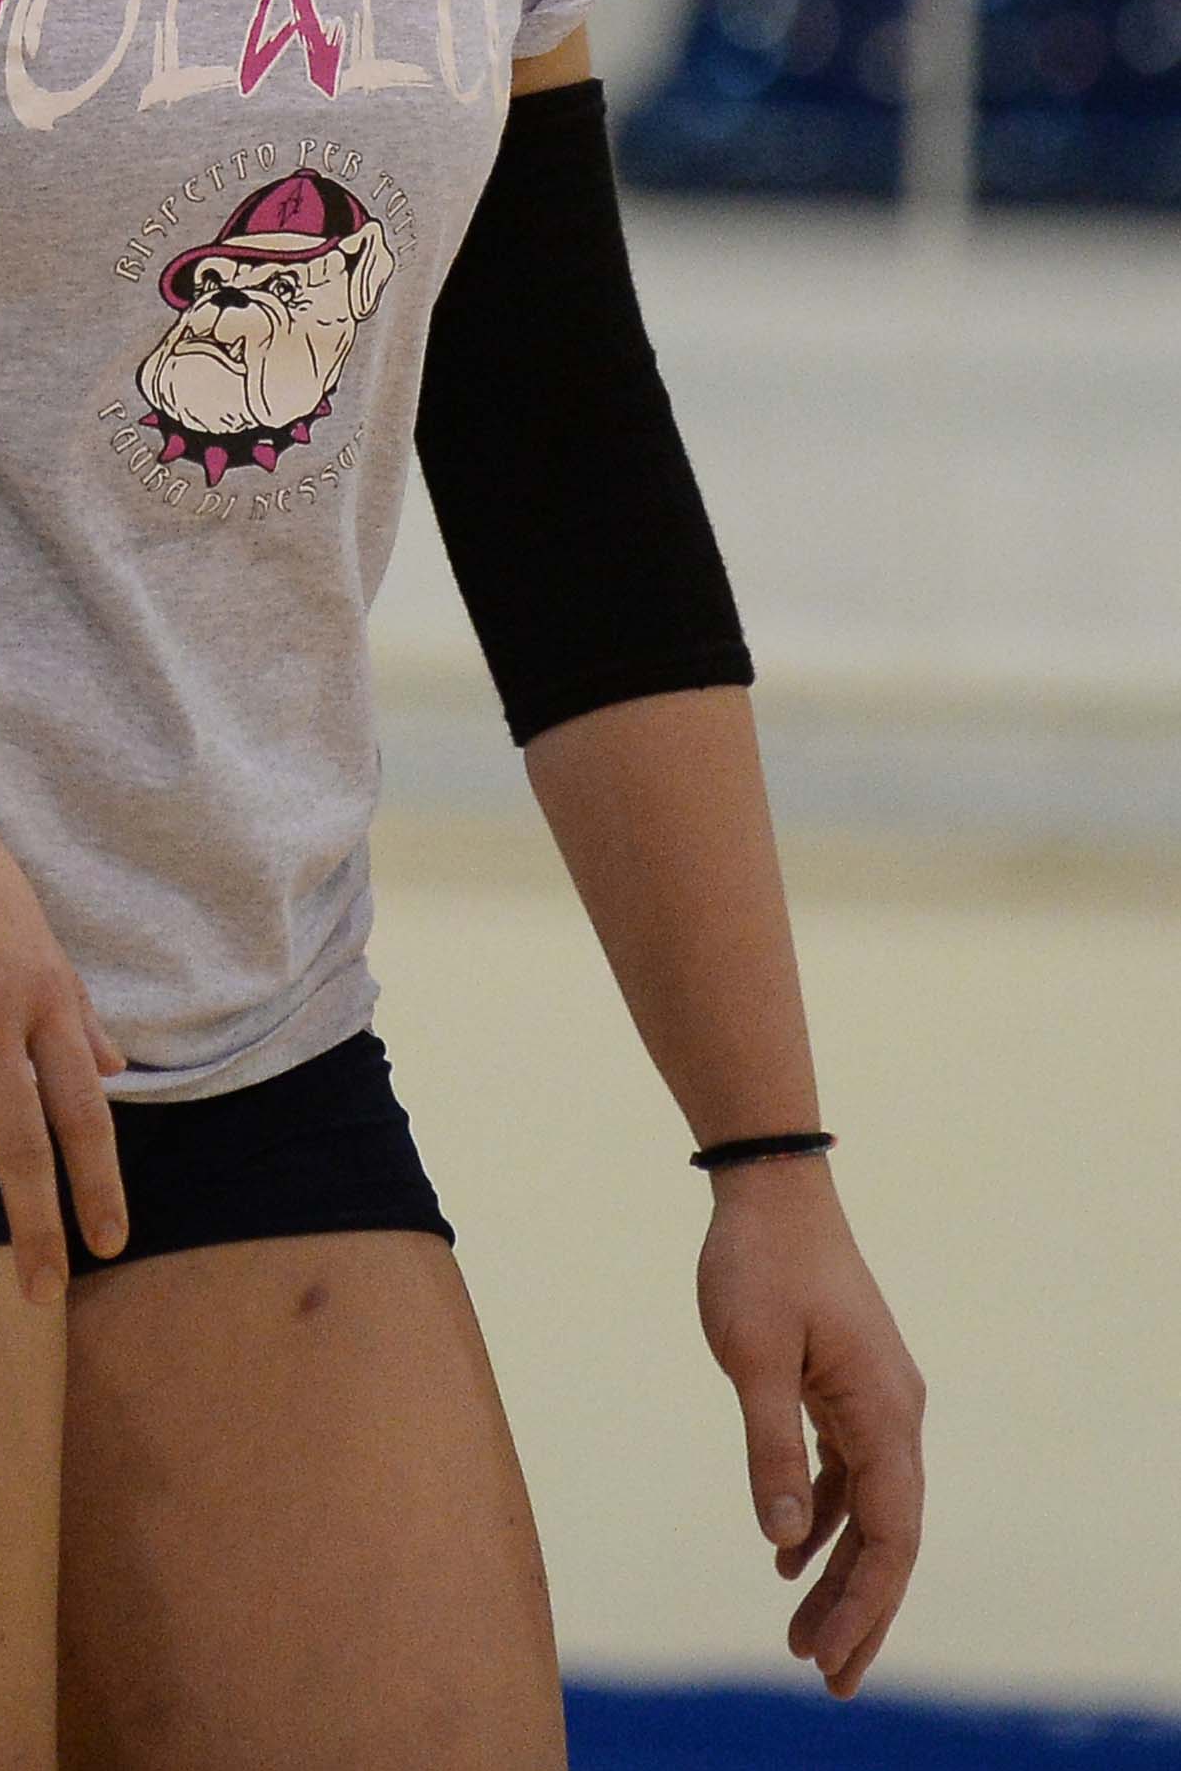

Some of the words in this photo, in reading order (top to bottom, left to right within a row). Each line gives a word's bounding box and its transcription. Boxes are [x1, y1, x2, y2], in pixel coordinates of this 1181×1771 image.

[115, 142, 275, 283] RISPETTO
[299, 138, 364, 181] PER
[98, 400, 190, 506] PAURA
[195, 492, 237, 520] DI
